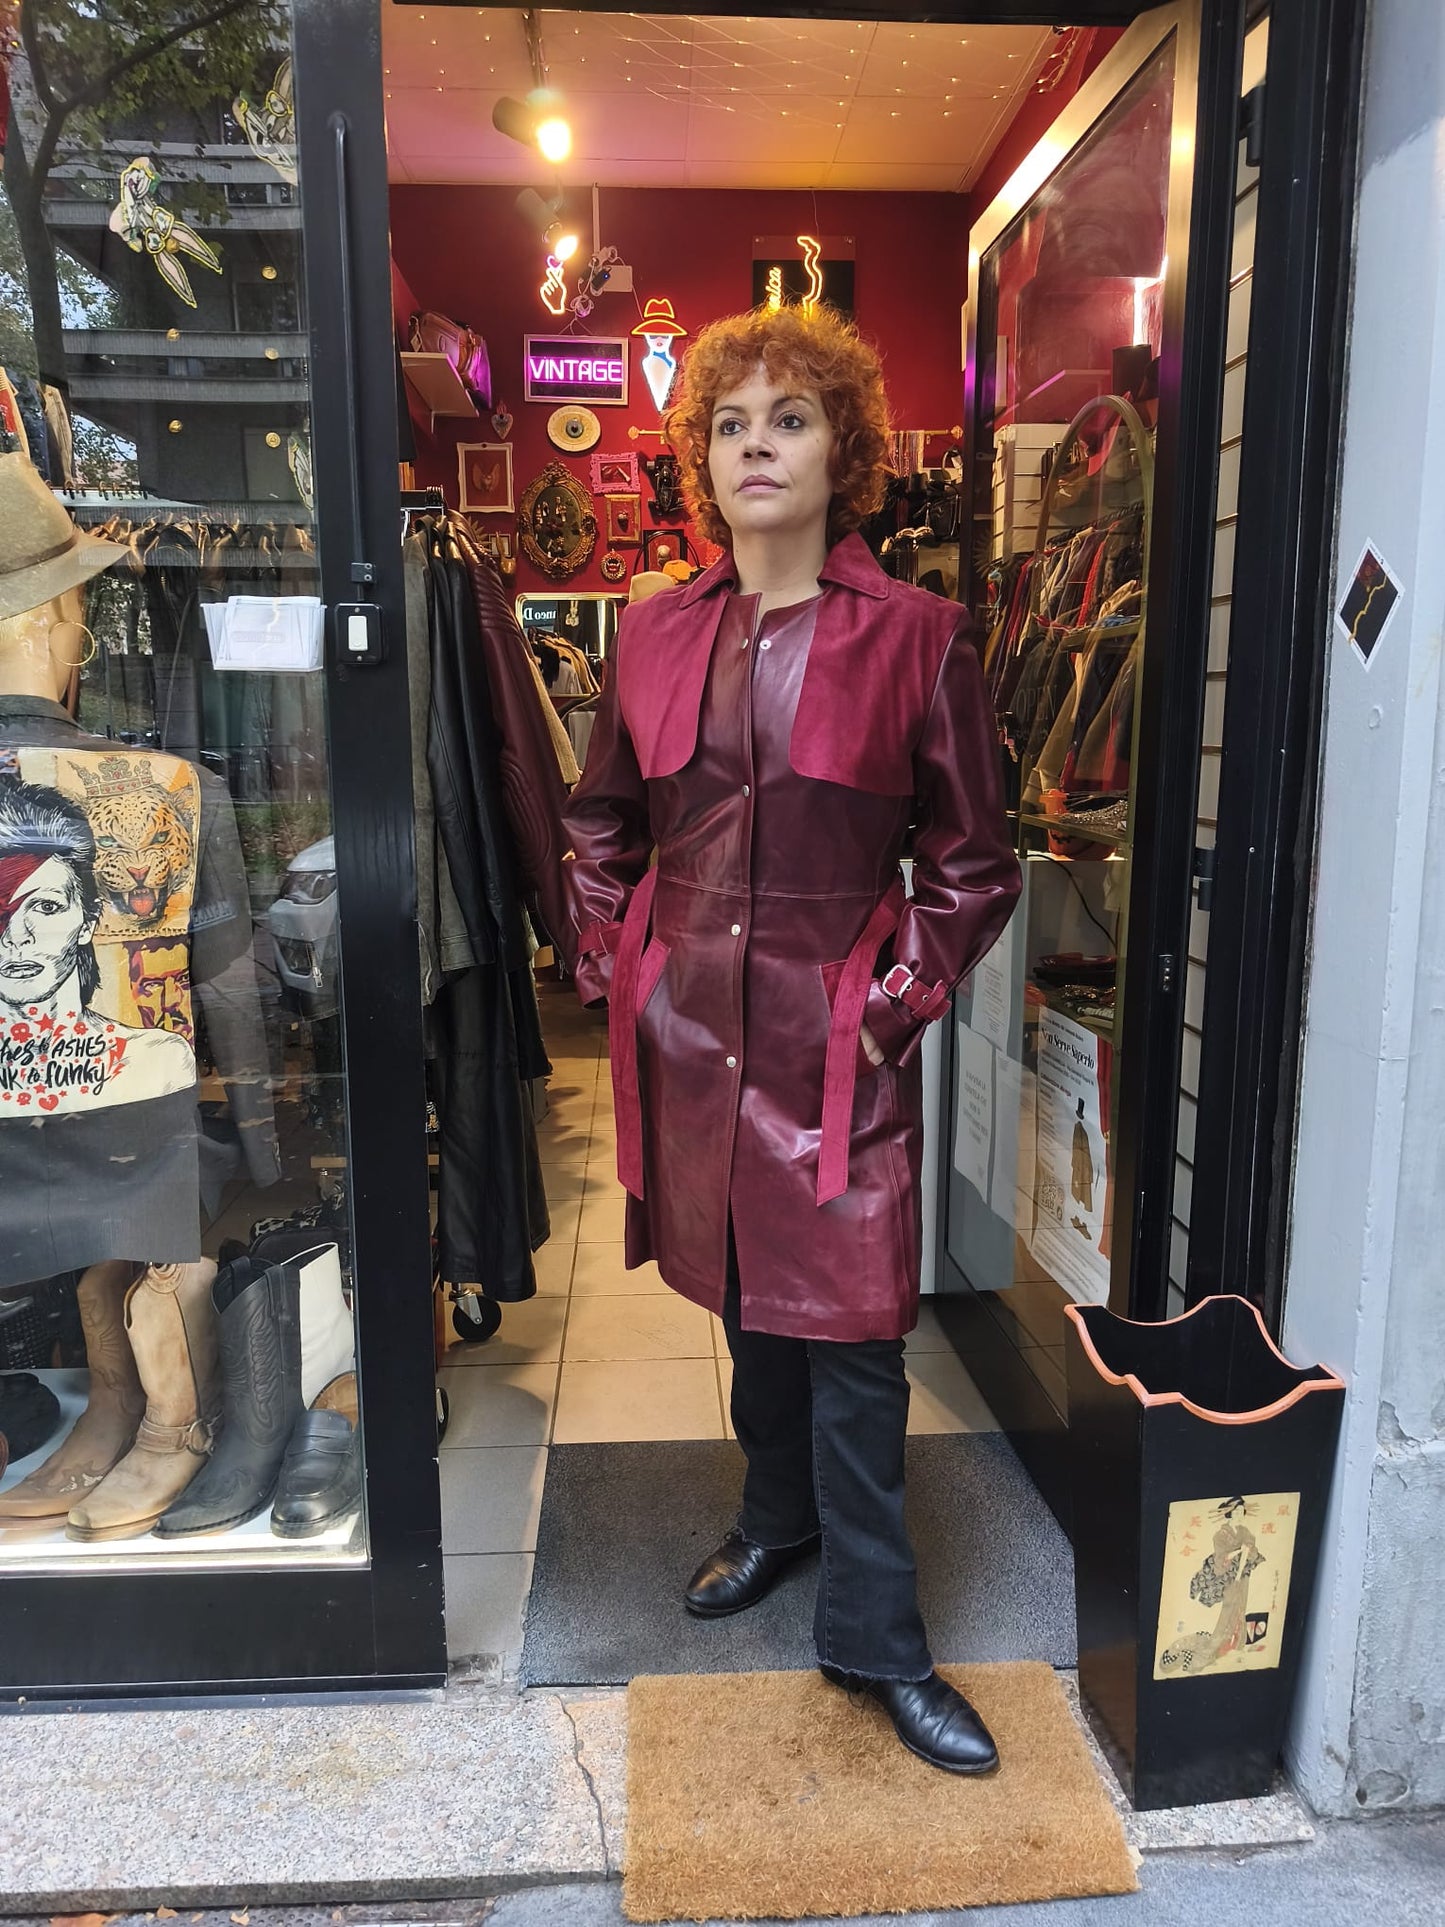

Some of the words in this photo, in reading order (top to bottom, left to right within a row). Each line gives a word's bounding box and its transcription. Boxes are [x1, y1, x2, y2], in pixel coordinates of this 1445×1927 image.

[529, 358, 624, 382] VINTAGE
[1016, 684, 1057, 724] OPEN
[51, 1033, 107, 1059] ASHES
[1053, 1034, 1071, 1053] Serve
[1071, 1044, 1095, 1070] Saperlo
[27, 1066, 41, 1085] to
[44, 1058, 112, 1096] funky
